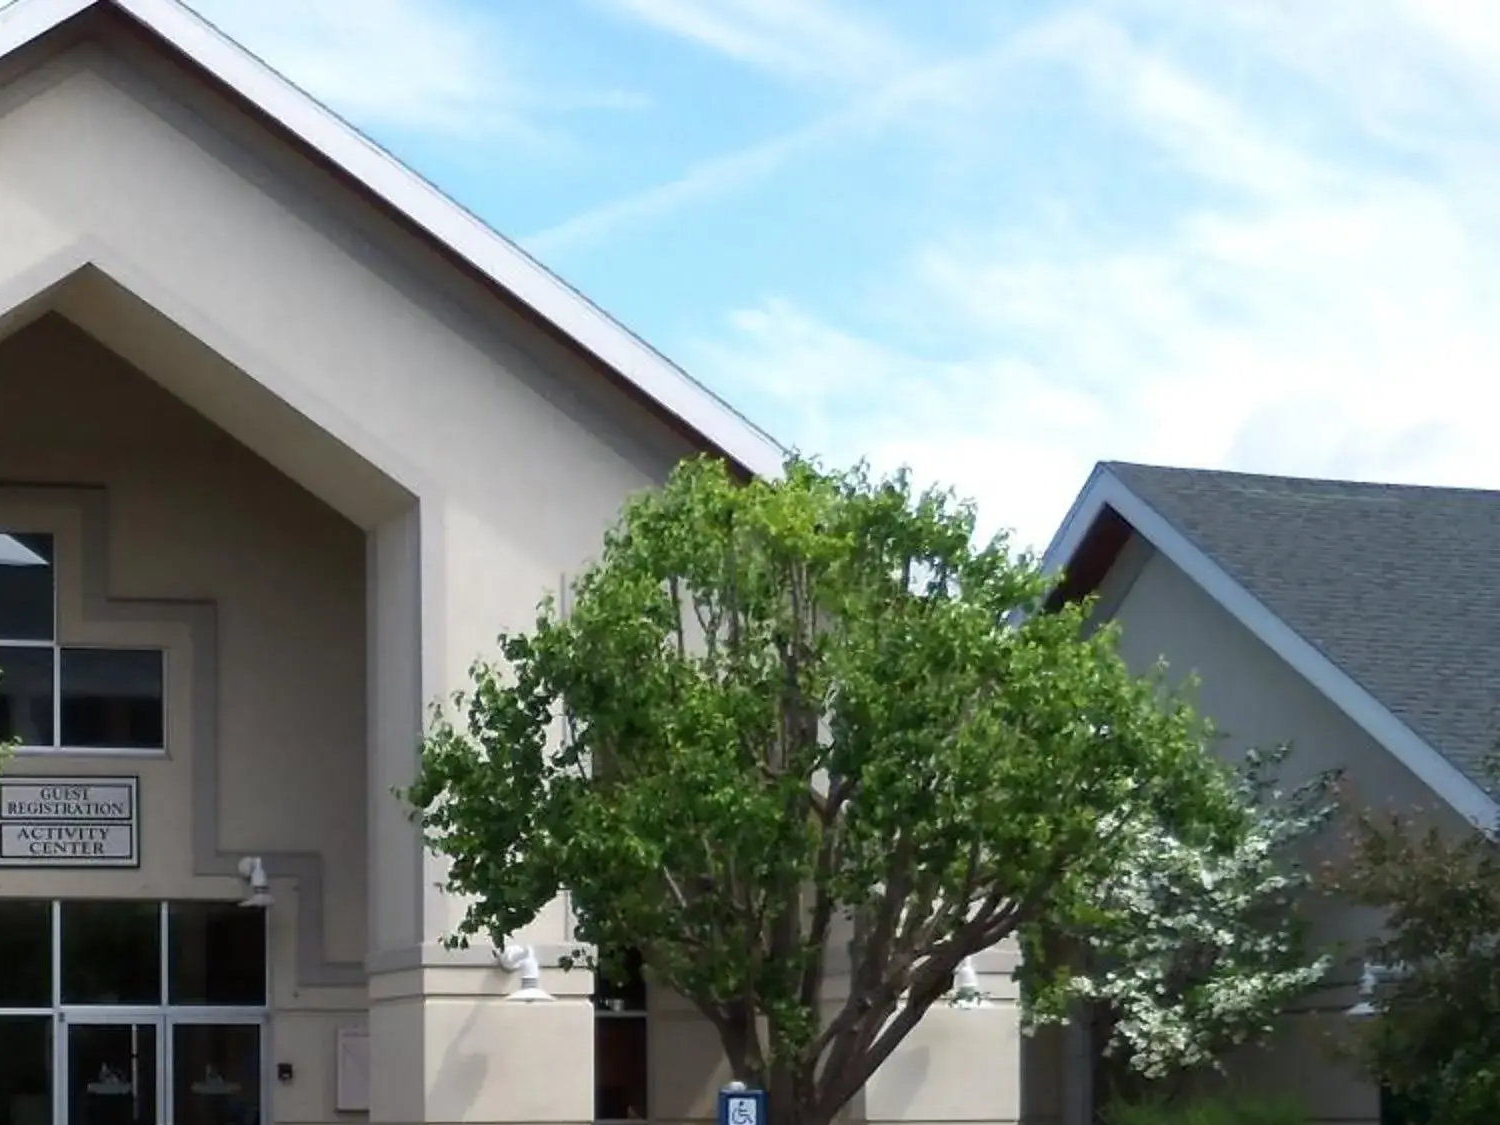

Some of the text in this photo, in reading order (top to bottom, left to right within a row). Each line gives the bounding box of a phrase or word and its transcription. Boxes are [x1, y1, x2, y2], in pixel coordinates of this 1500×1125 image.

[40, 787, 89, 800] GUEST
[7, 801, 124, 815] REGISTRATION
[18, 827, 109, 840] ACTIVITY
[29, 842, 104, 855] CENTER
